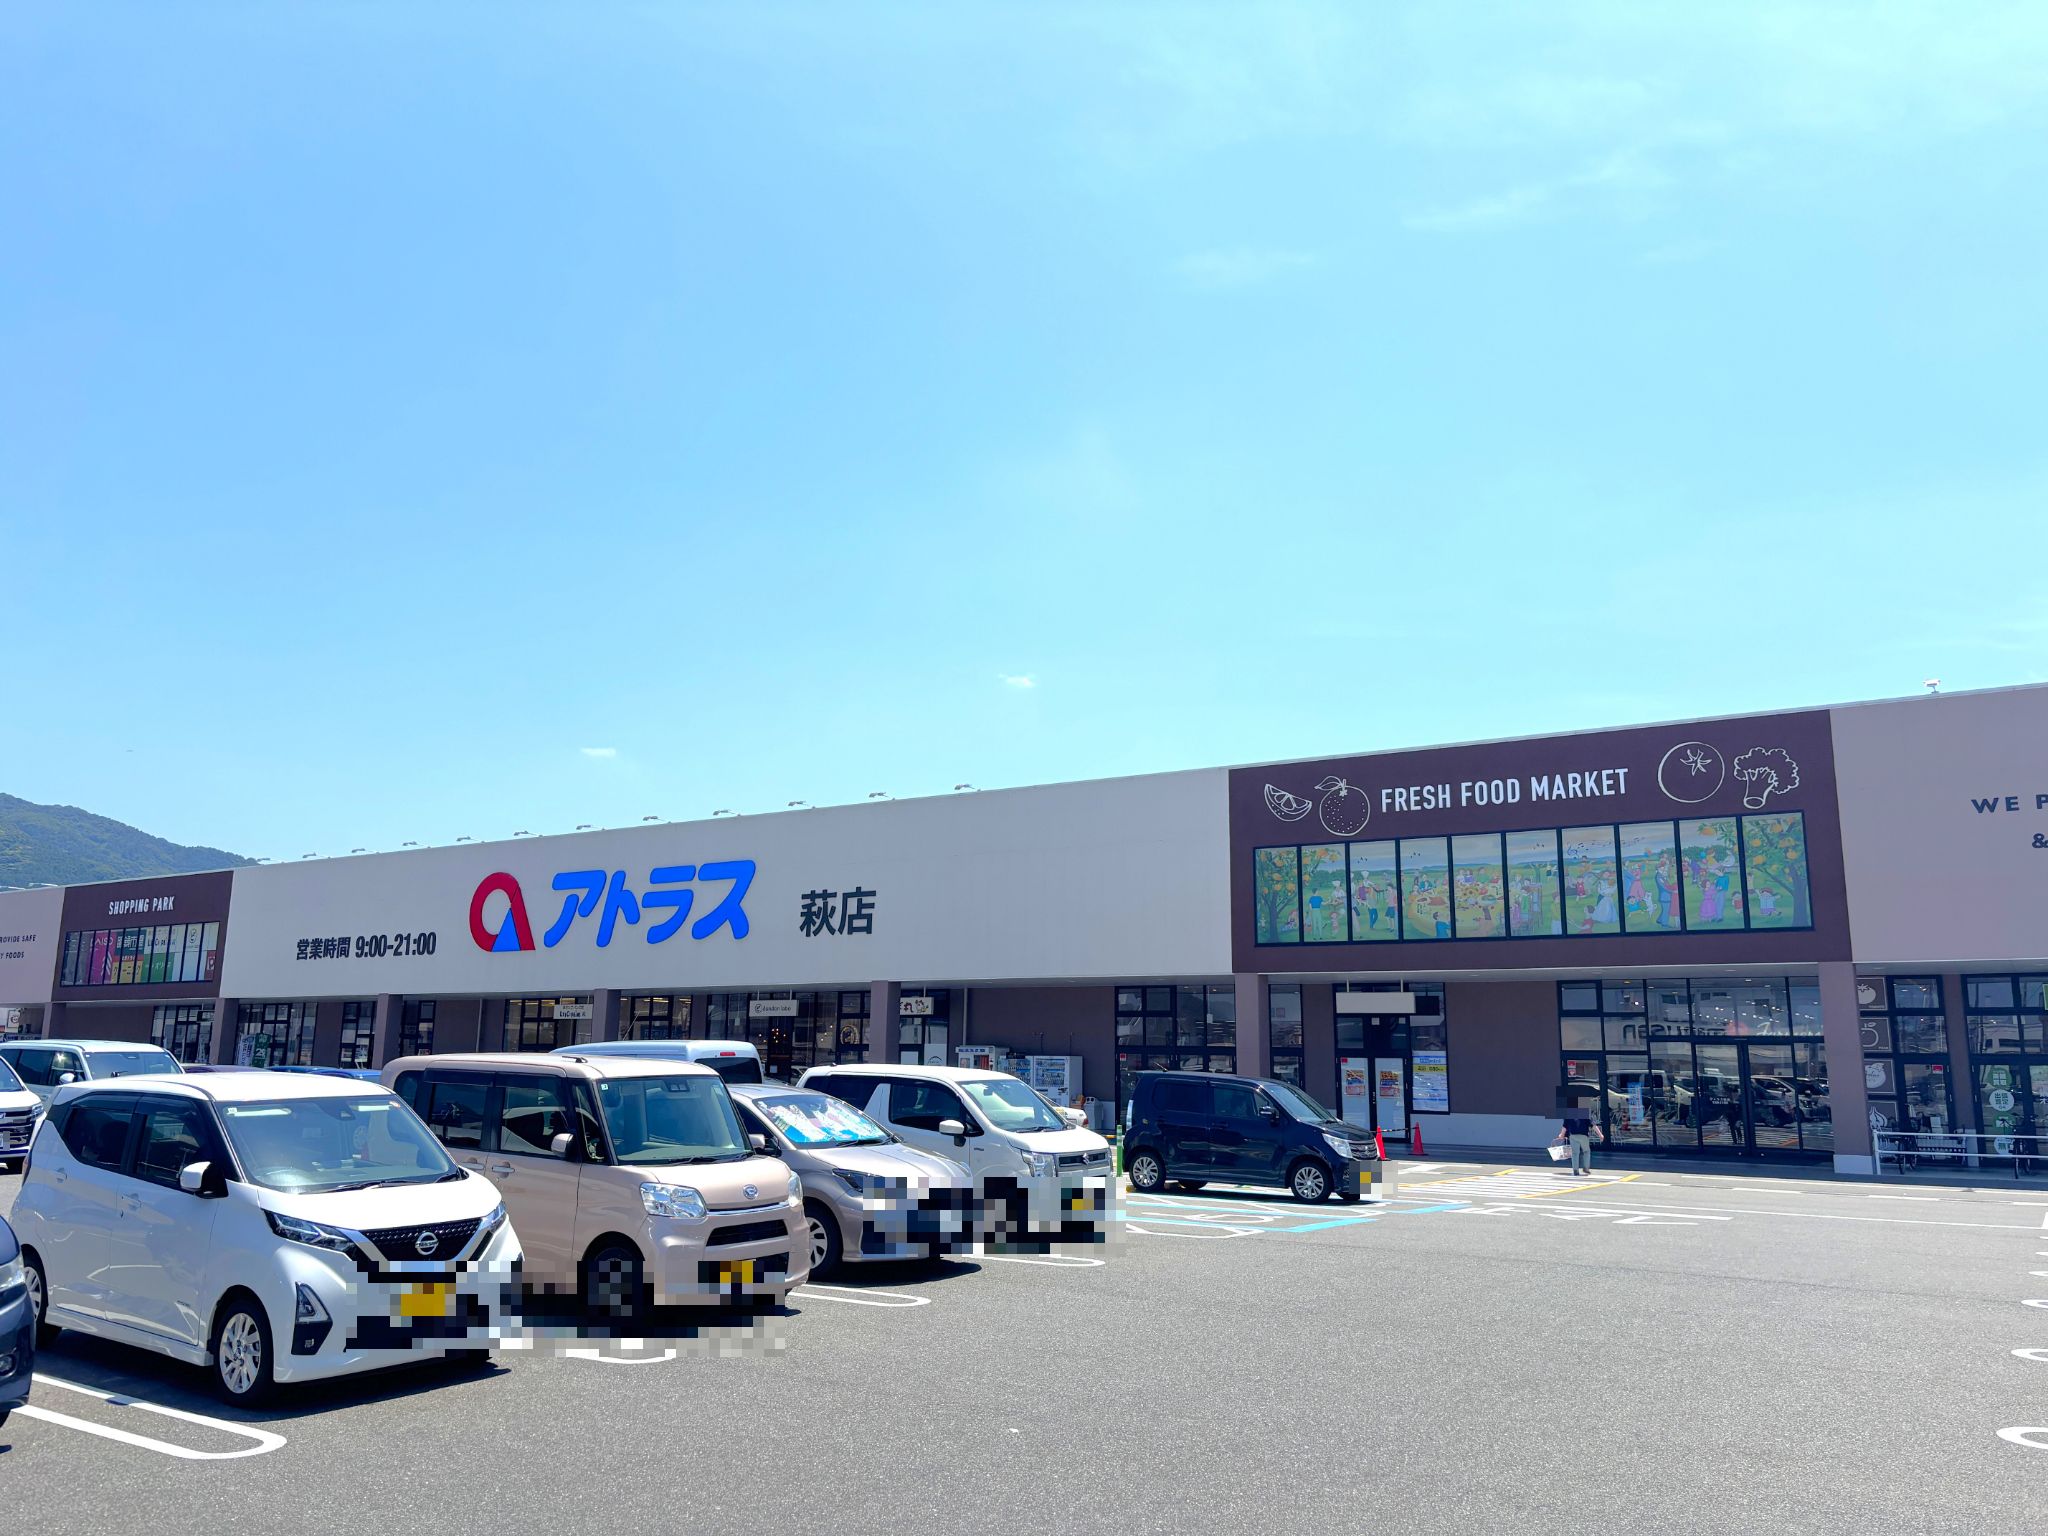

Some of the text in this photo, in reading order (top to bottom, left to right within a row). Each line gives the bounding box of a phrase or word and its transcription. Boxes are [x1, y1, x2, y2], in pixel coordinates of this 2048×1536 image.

[1381, 768, 1630, 813] FRESH FOOD MARKET
[1971, 796, 2020, 813] WE
[108, 896, 175, 915] SHOPPING PARK
[543, 859, 757, 948] アトラス
[798, 886, 876, 938] 萩店
[21, 934, 37, 942] SAFE
[296, 931, 437, 961] 営業時間 9:00-21:00
[5, 951, 25, 959] FOODS
